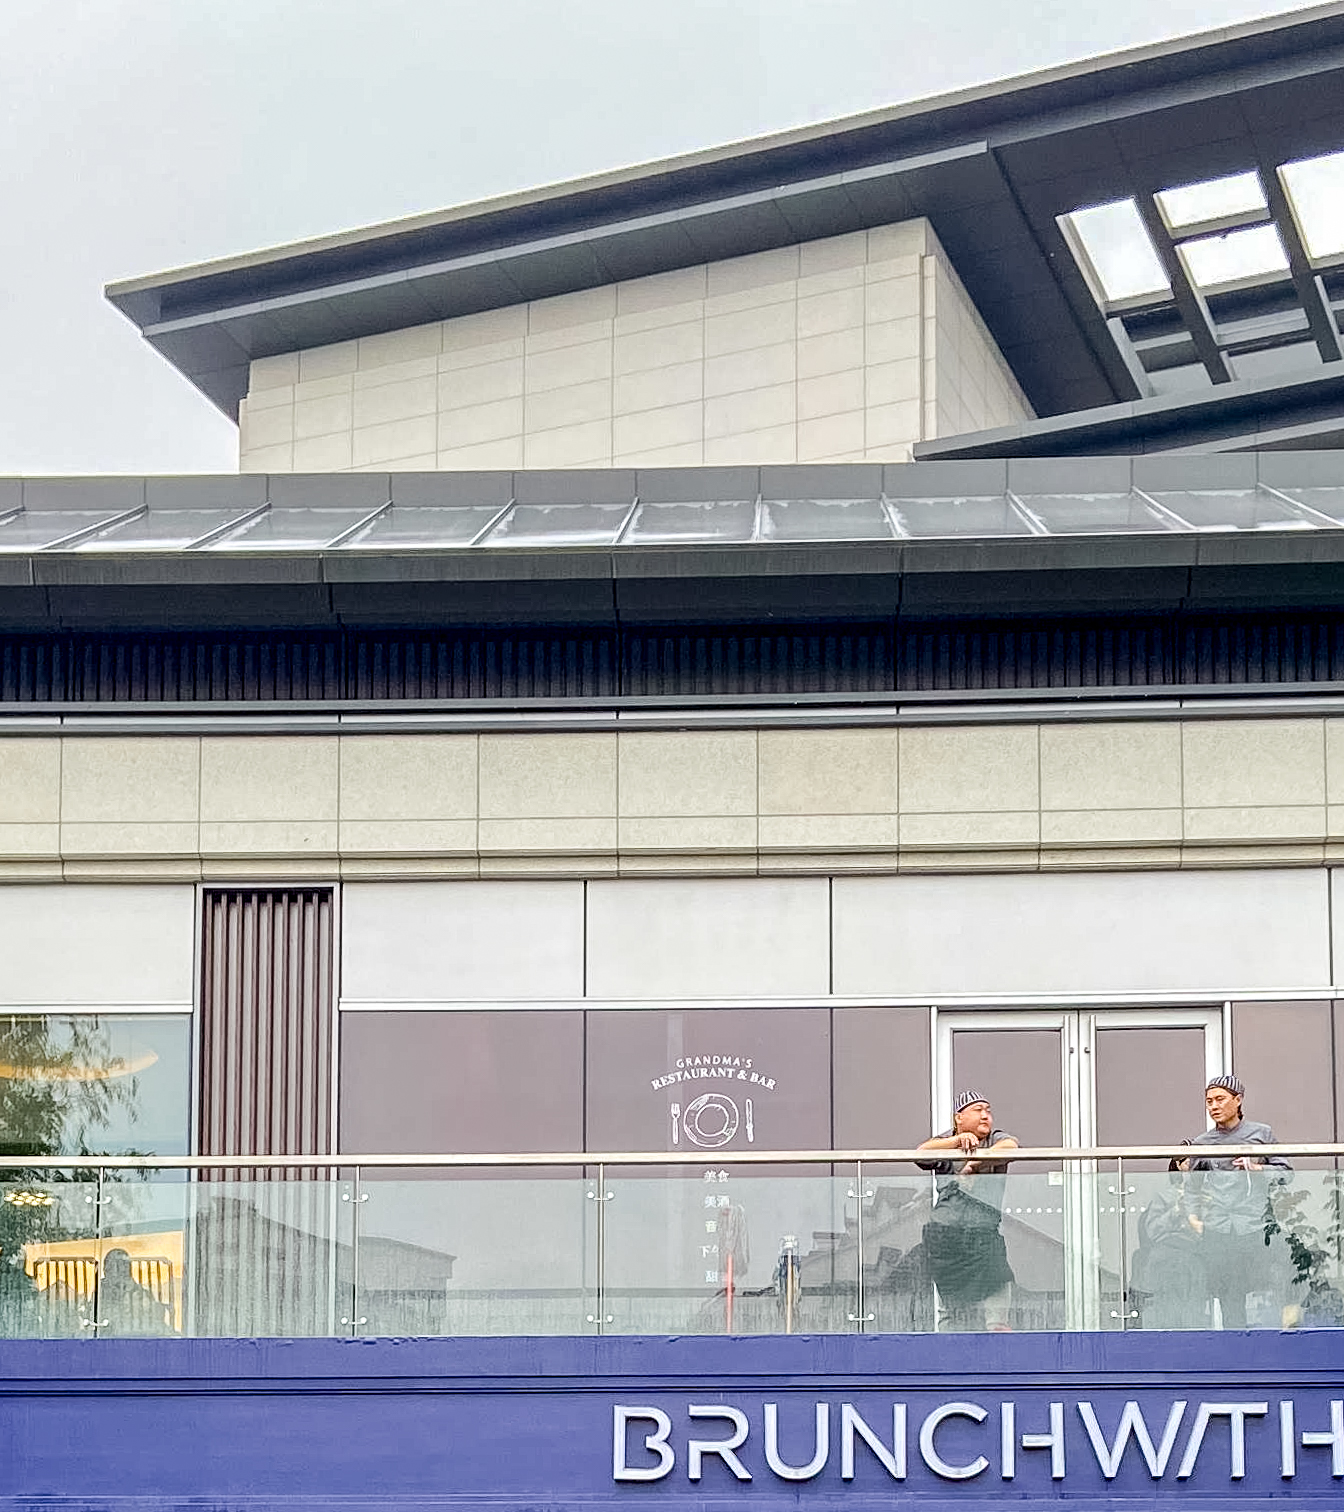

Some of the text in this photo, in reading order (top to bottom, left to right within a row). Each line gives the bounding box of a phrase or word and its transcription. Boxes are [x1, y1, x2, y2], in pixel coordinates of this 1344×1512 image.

[676, 1055, 753, 1068] GRANDMA'S
[650, 1067, 777, 1091] RESTAURANT & BAR
